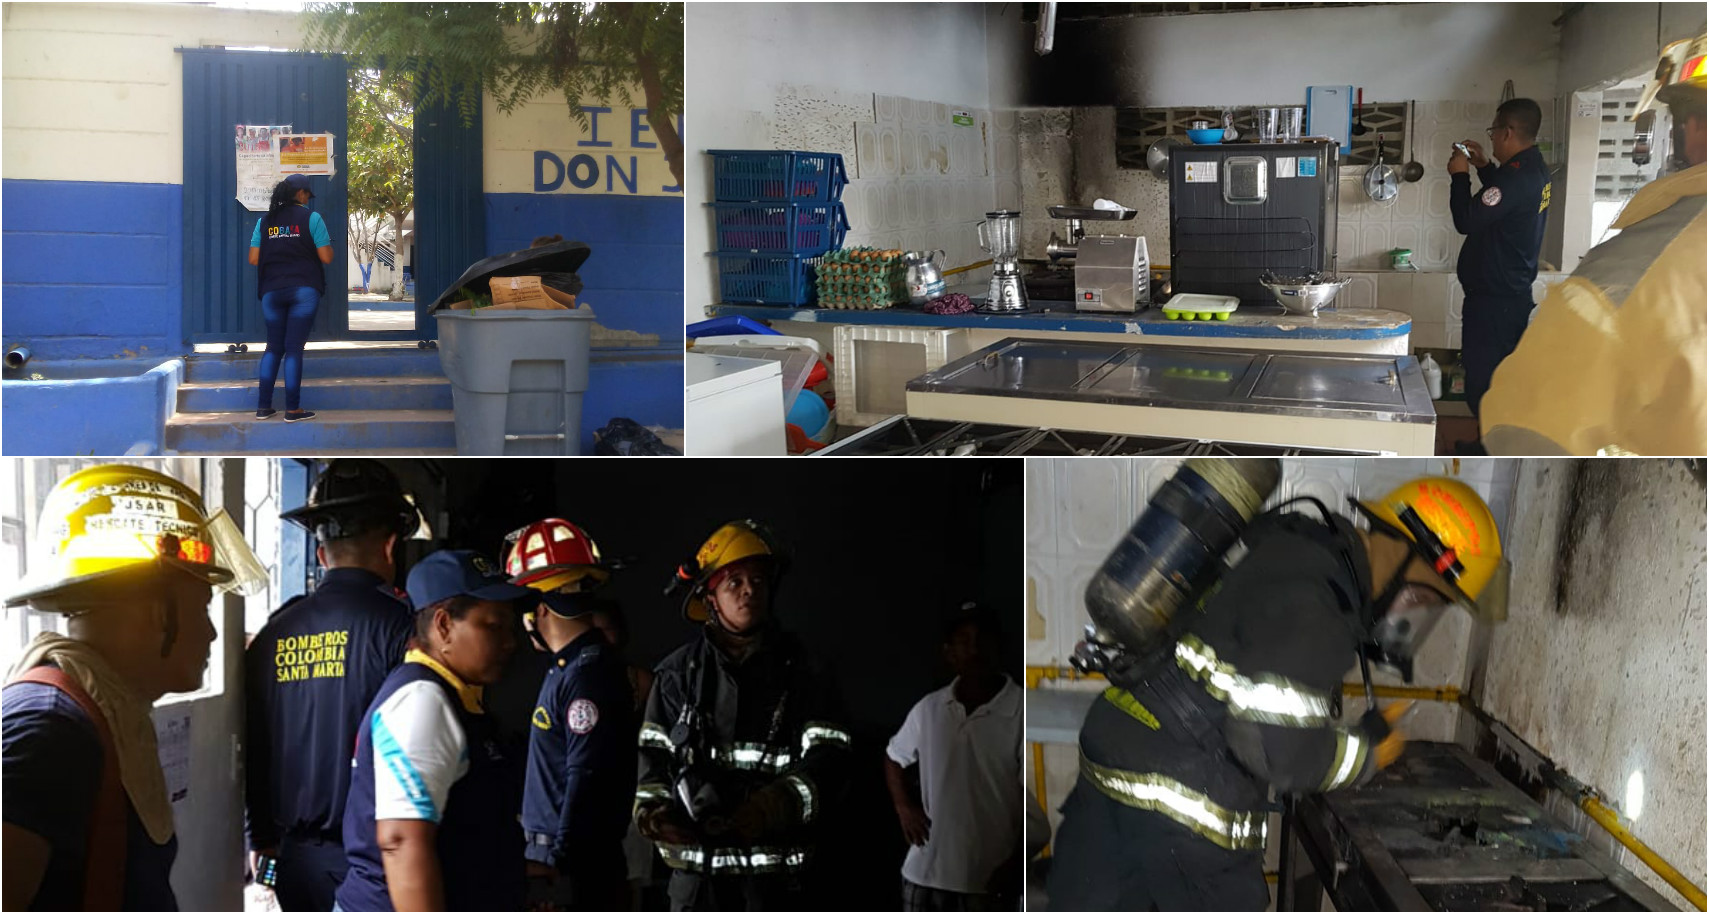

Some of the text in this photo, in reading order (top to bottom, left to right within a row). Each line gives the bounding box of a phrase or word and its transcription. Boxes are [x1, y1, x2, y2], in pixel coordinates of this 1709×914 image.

[534, 151, 637, 193] DON
[277, 631, 348, 652] BOMBEROS
[275, 646, 345, 666] COLOMBIA
[276, 662, 345, 682] SANTA MARTA
